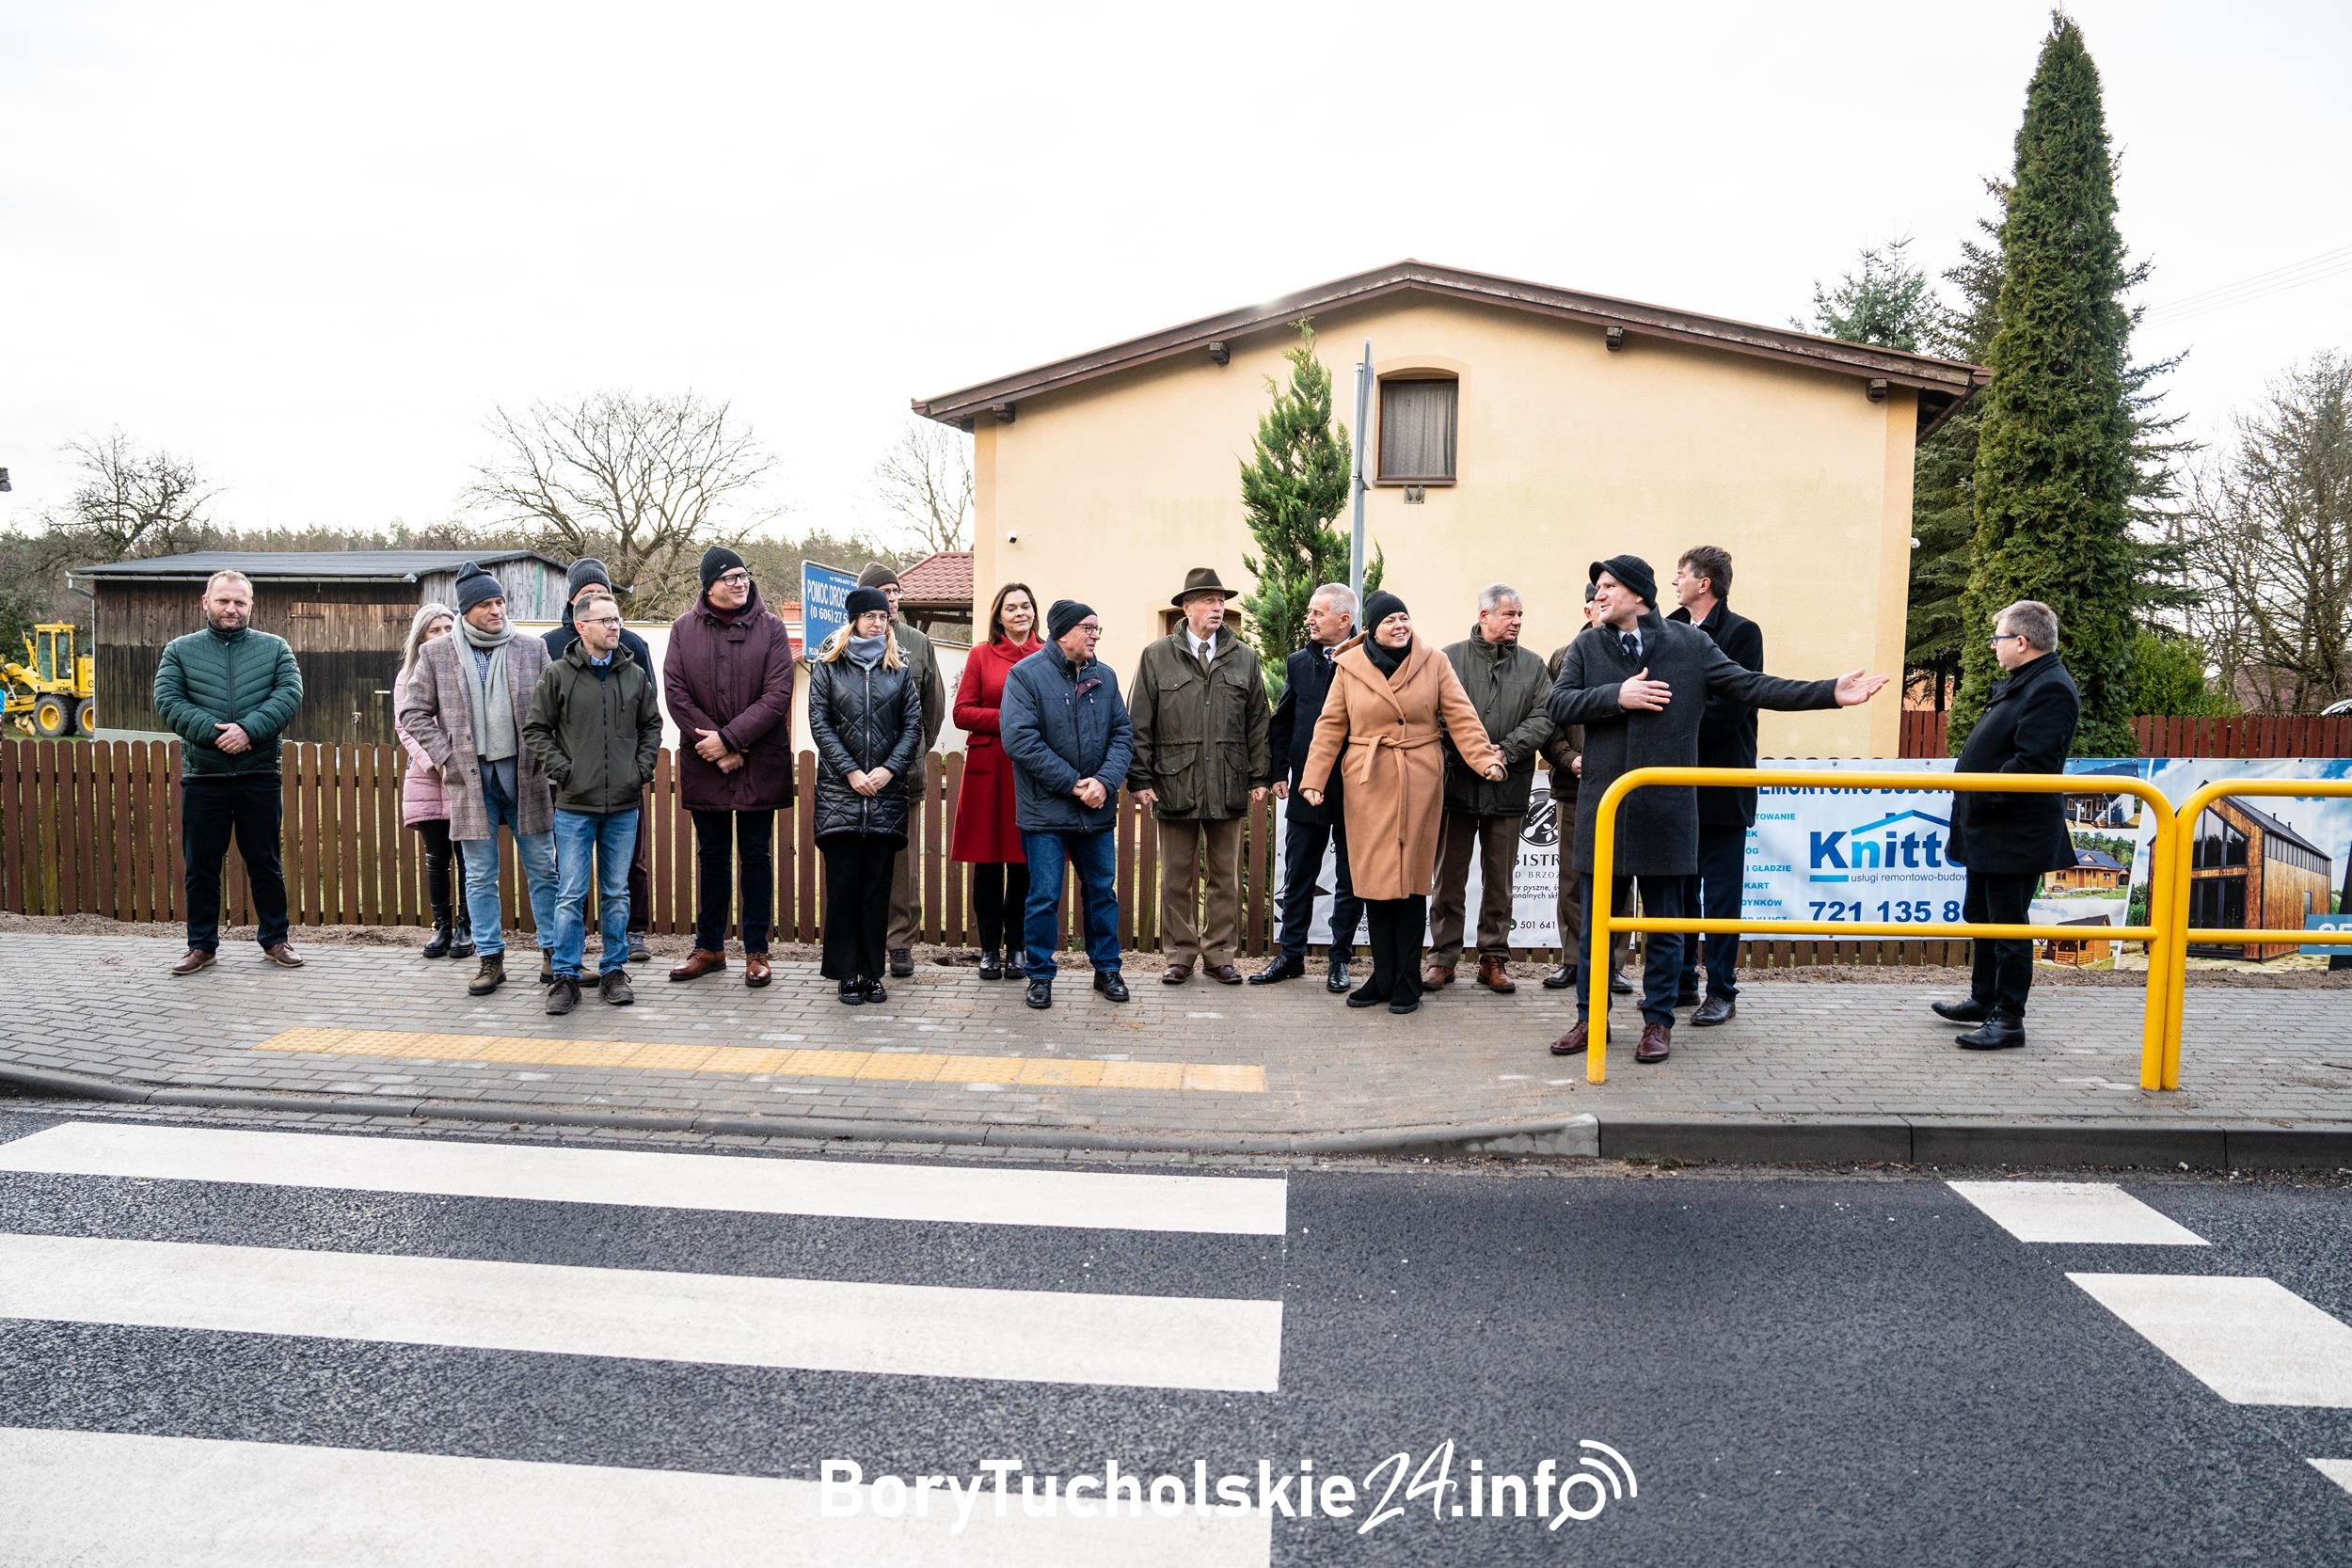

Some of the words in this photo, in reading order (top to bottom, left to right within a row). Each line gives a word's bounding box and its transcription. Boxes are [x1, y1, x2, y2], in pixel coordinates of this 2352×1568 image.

[807, 579, 828, 605] POMOC
[1851, 872, 1879, 883] usługi
[1809, 901, 1862, 922] 721
[1877, 900, 1931, 923] 135
